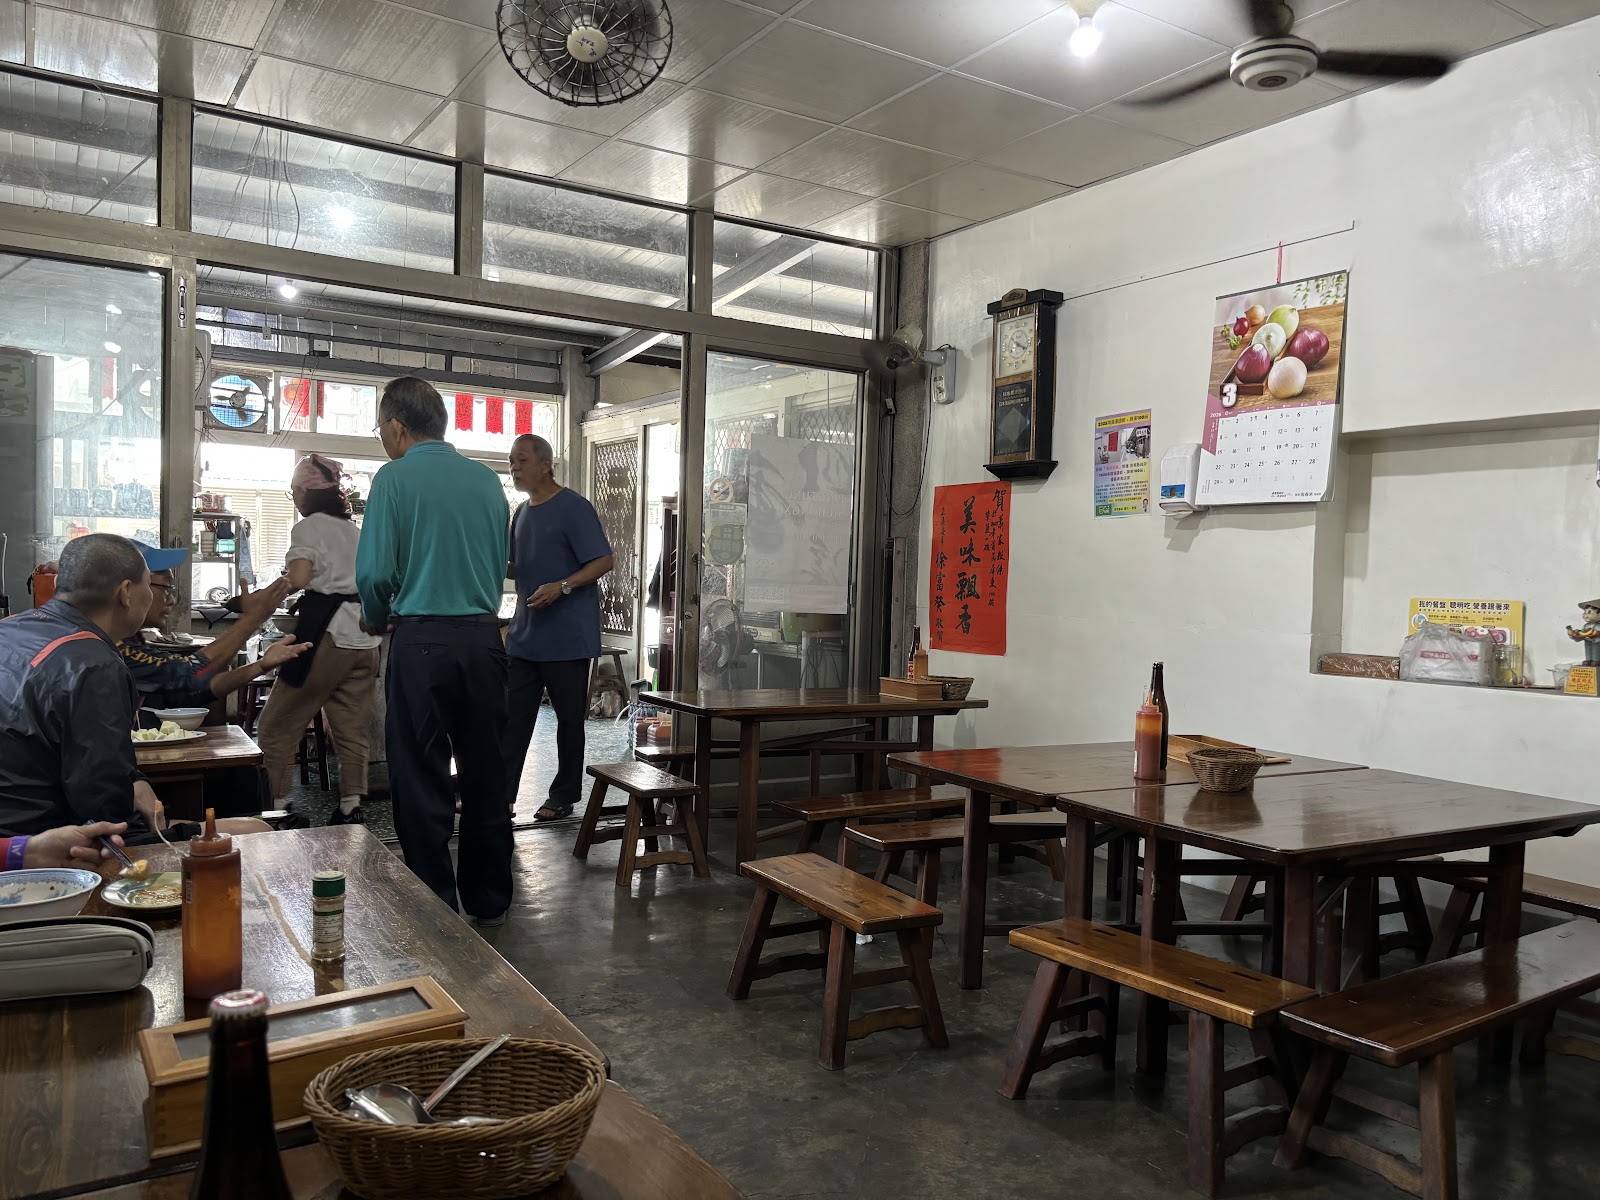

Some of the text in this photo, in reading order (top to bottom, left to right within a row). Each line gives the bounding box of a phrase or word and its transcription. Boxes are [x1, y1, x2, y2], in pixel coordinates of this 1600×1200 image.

[1222, 383, 1237, 407] 3
[954, 495, 981, 635] 美味飄香
[1418, 600, 1511, 611] 我的餐盤 聰明吃 營養跟著來
